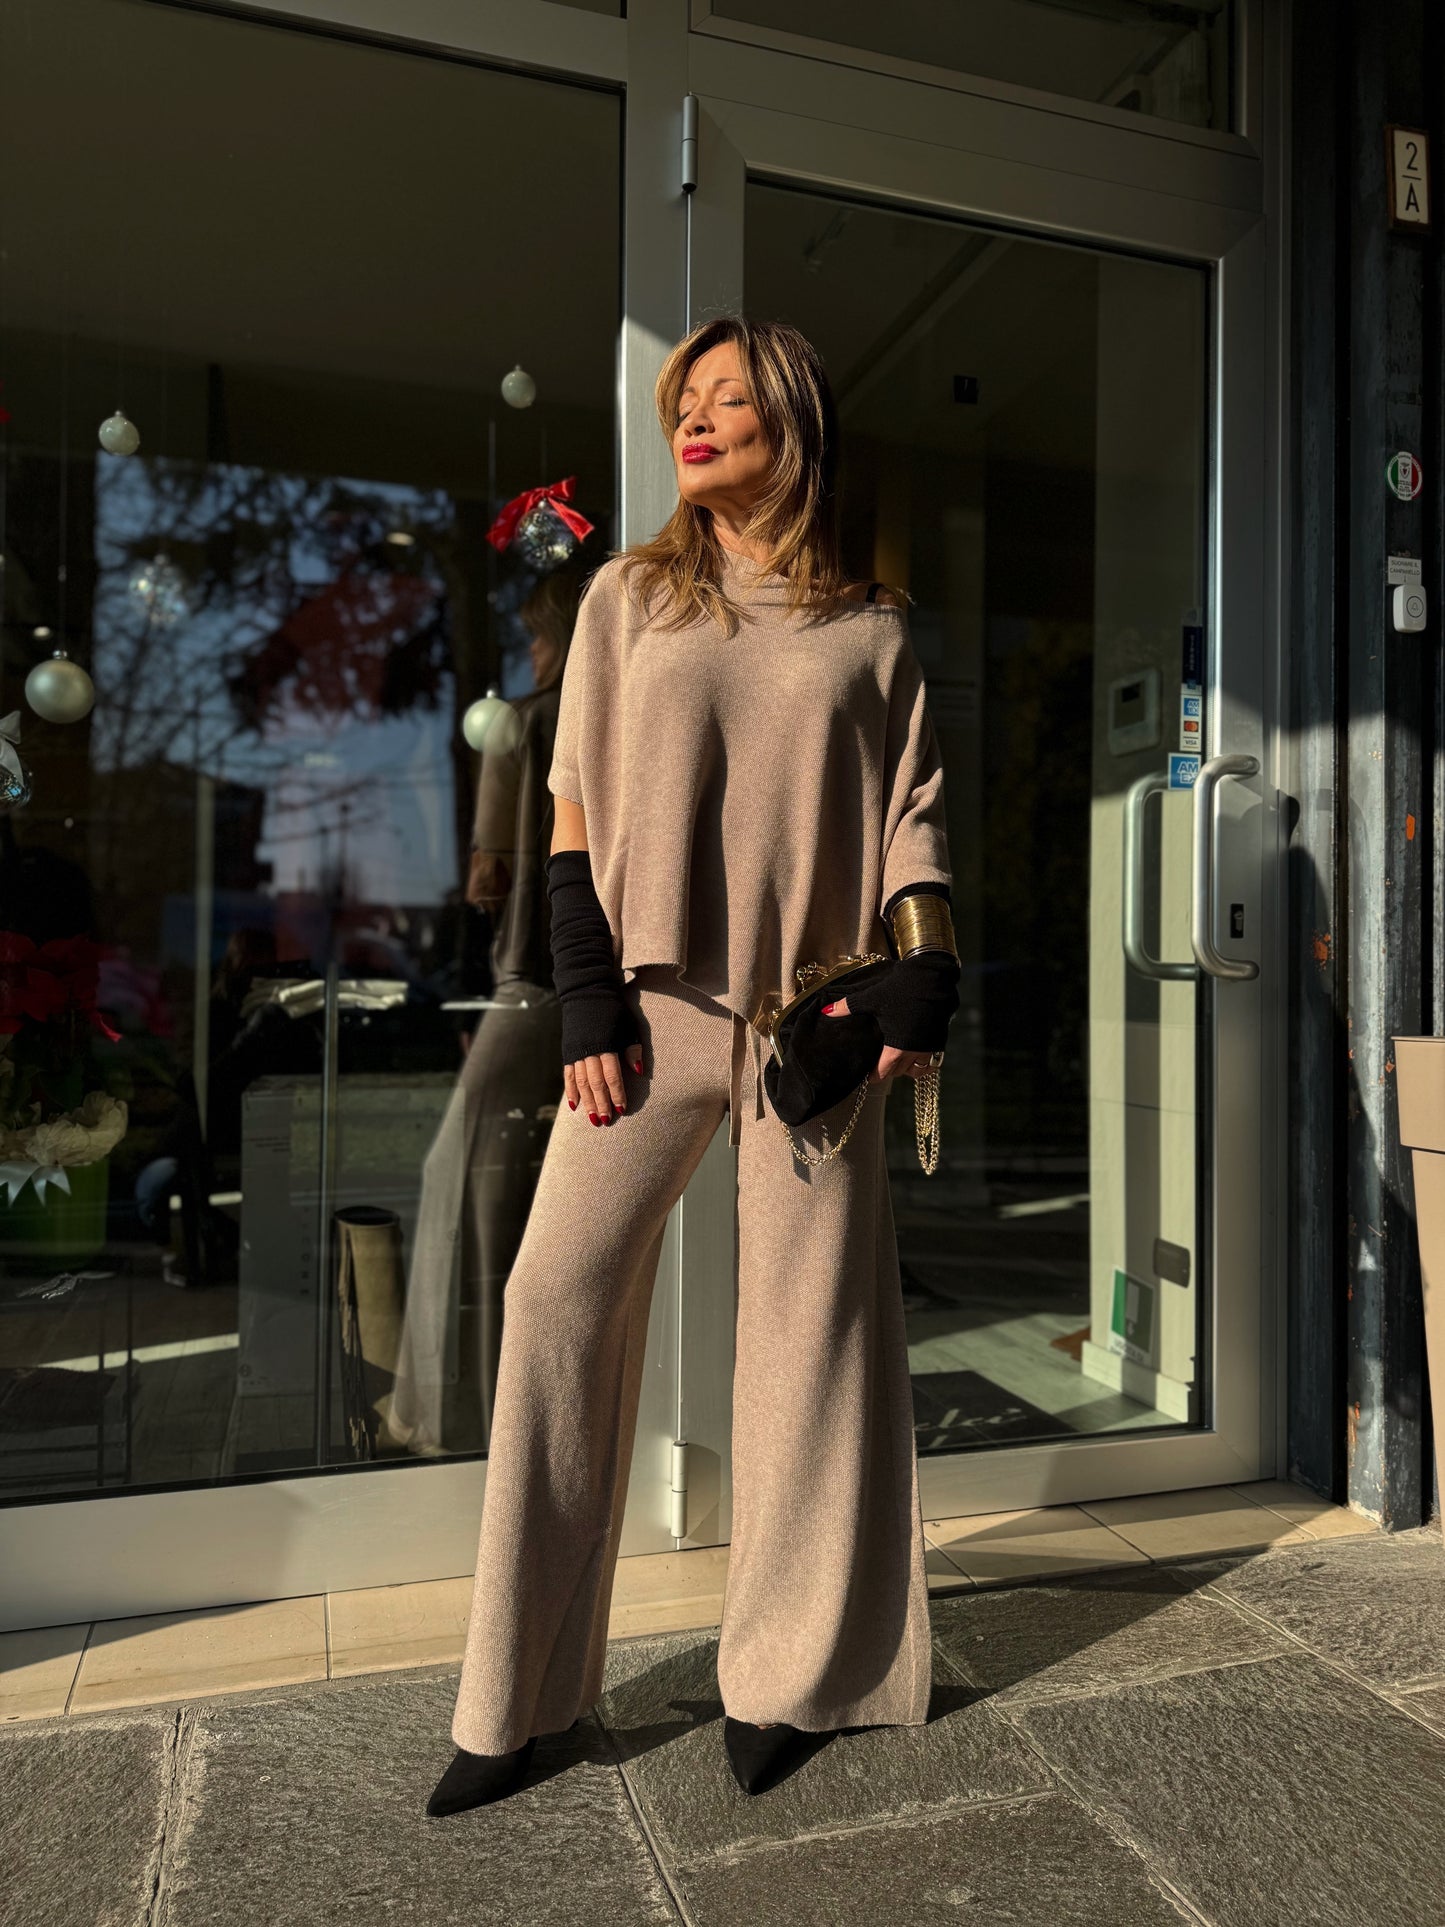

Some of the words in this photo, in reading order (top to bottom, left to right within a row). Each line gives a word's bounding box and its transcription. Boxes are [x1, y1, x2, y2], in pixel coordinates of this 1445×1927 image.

[1405, 141, 1418, 171] 2
[1405, 182, 1420, 213] A
[1177, 761, 1199, 774] AM
